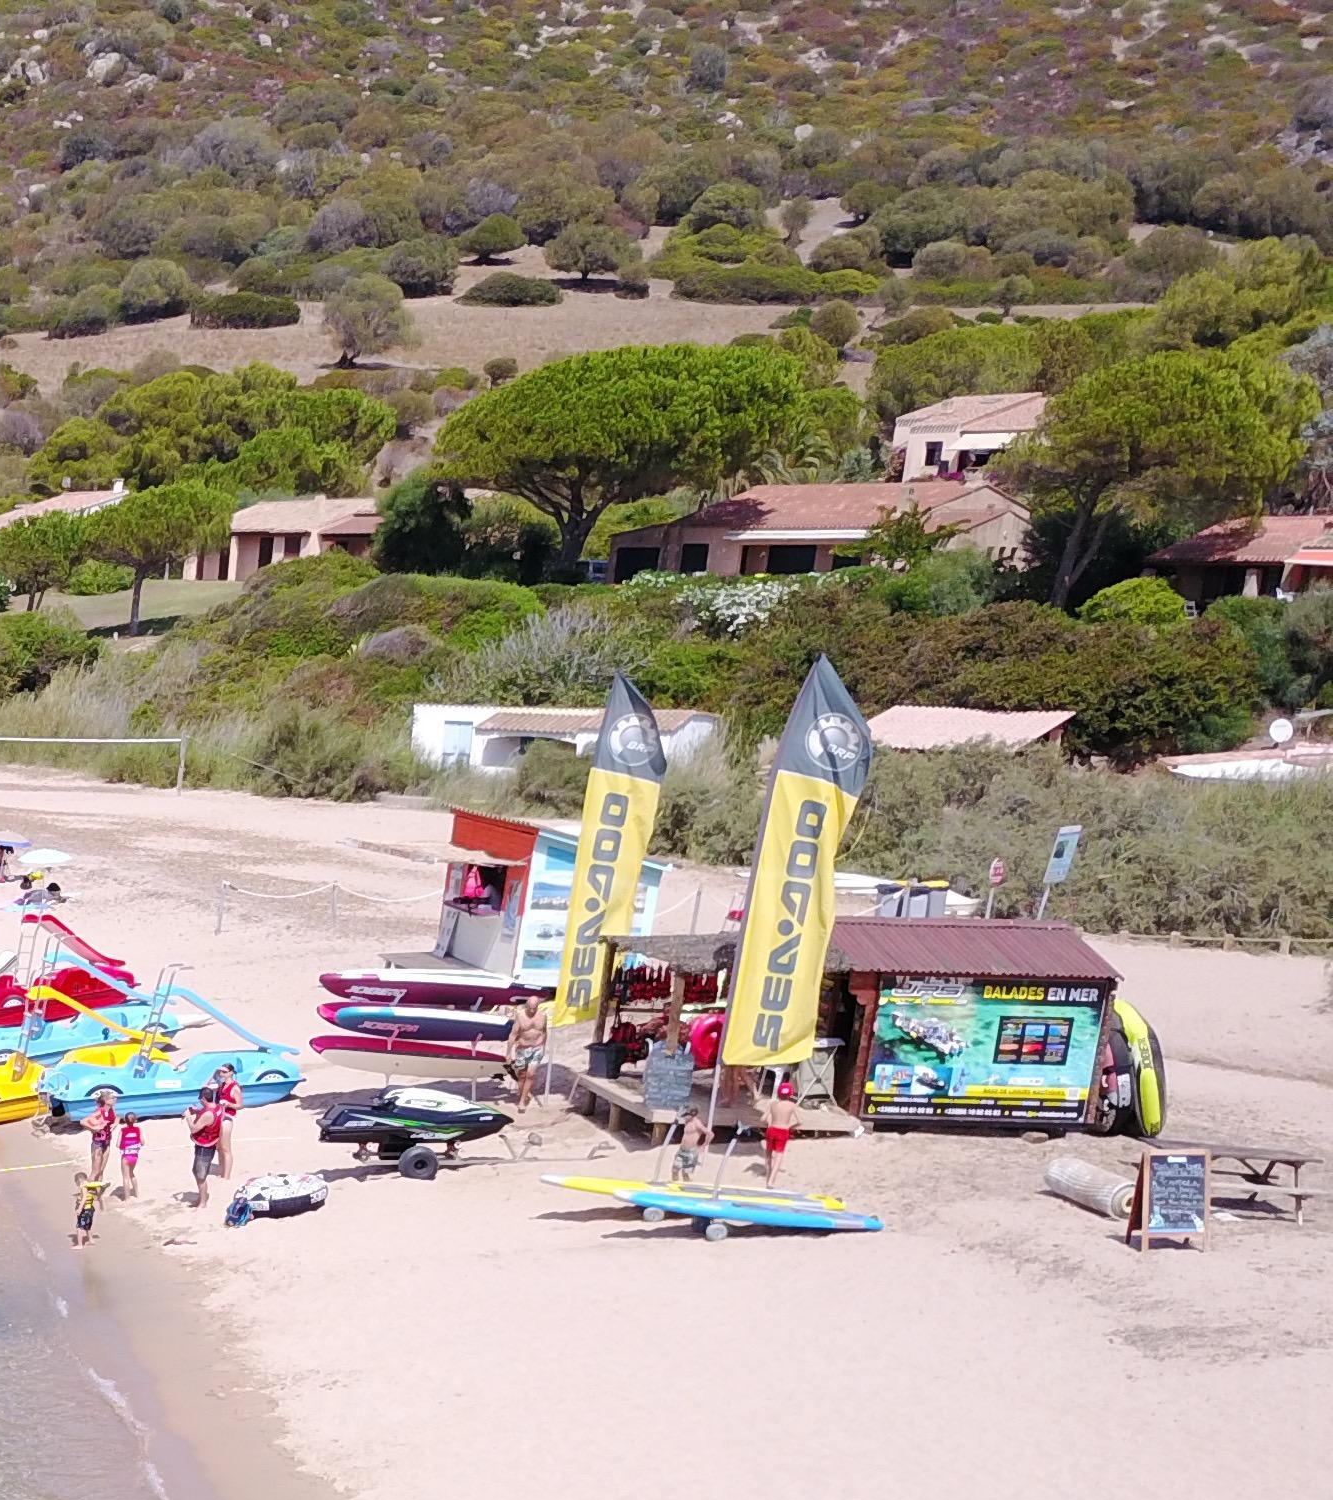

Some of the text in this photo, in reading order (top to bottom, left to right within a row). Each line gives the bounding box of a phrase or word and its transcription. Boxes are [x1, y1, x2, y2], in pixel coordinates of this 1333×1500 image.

[982, 985, 1099, 1002] BALADES EN MER
